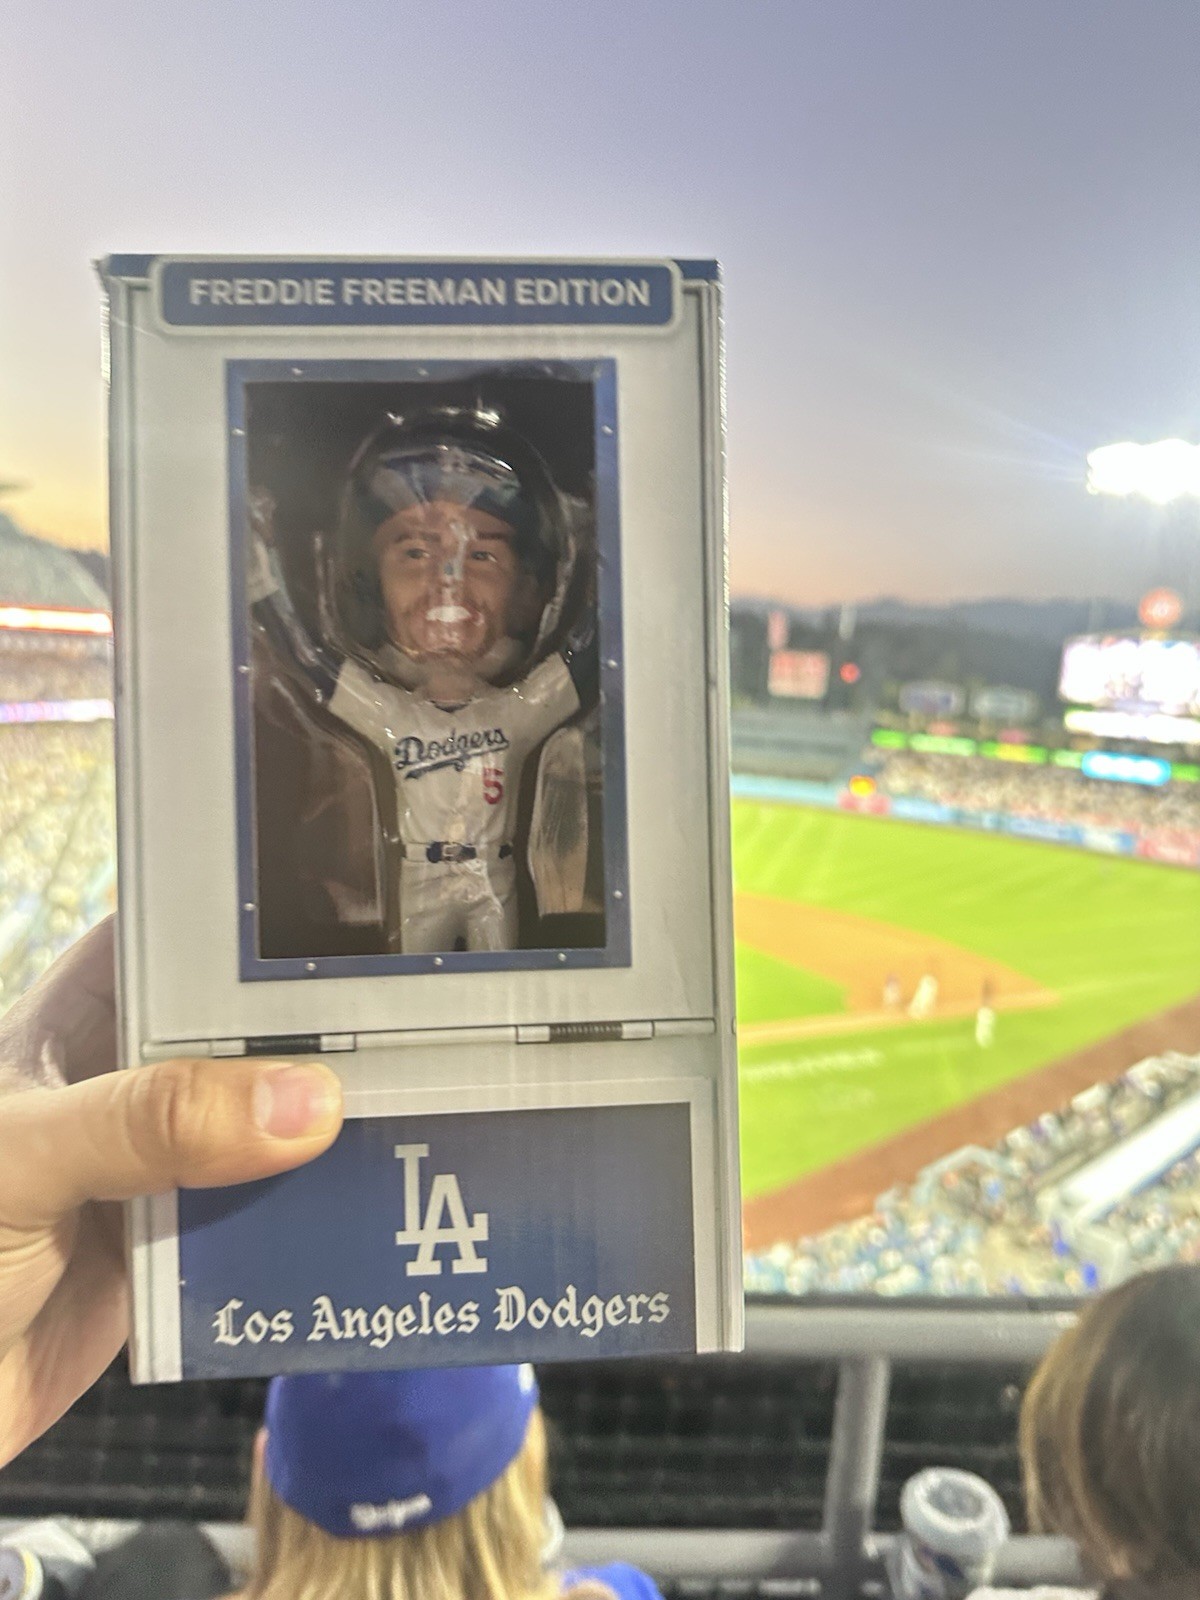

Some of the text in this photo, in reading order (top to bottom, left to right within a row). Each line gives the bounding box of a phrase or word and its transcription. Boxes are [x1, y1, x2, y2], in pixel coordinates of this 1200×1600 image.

[190, 277, 651, 307] FREDDIE FREEMAN EDITION
[394, 728, 508, 775] Dodgers
[483, 767, 504, 805] 5
[394, 1143, 489, 1277] LA
[212, 1286, 670, 1349] Los Angeles Dodgers
